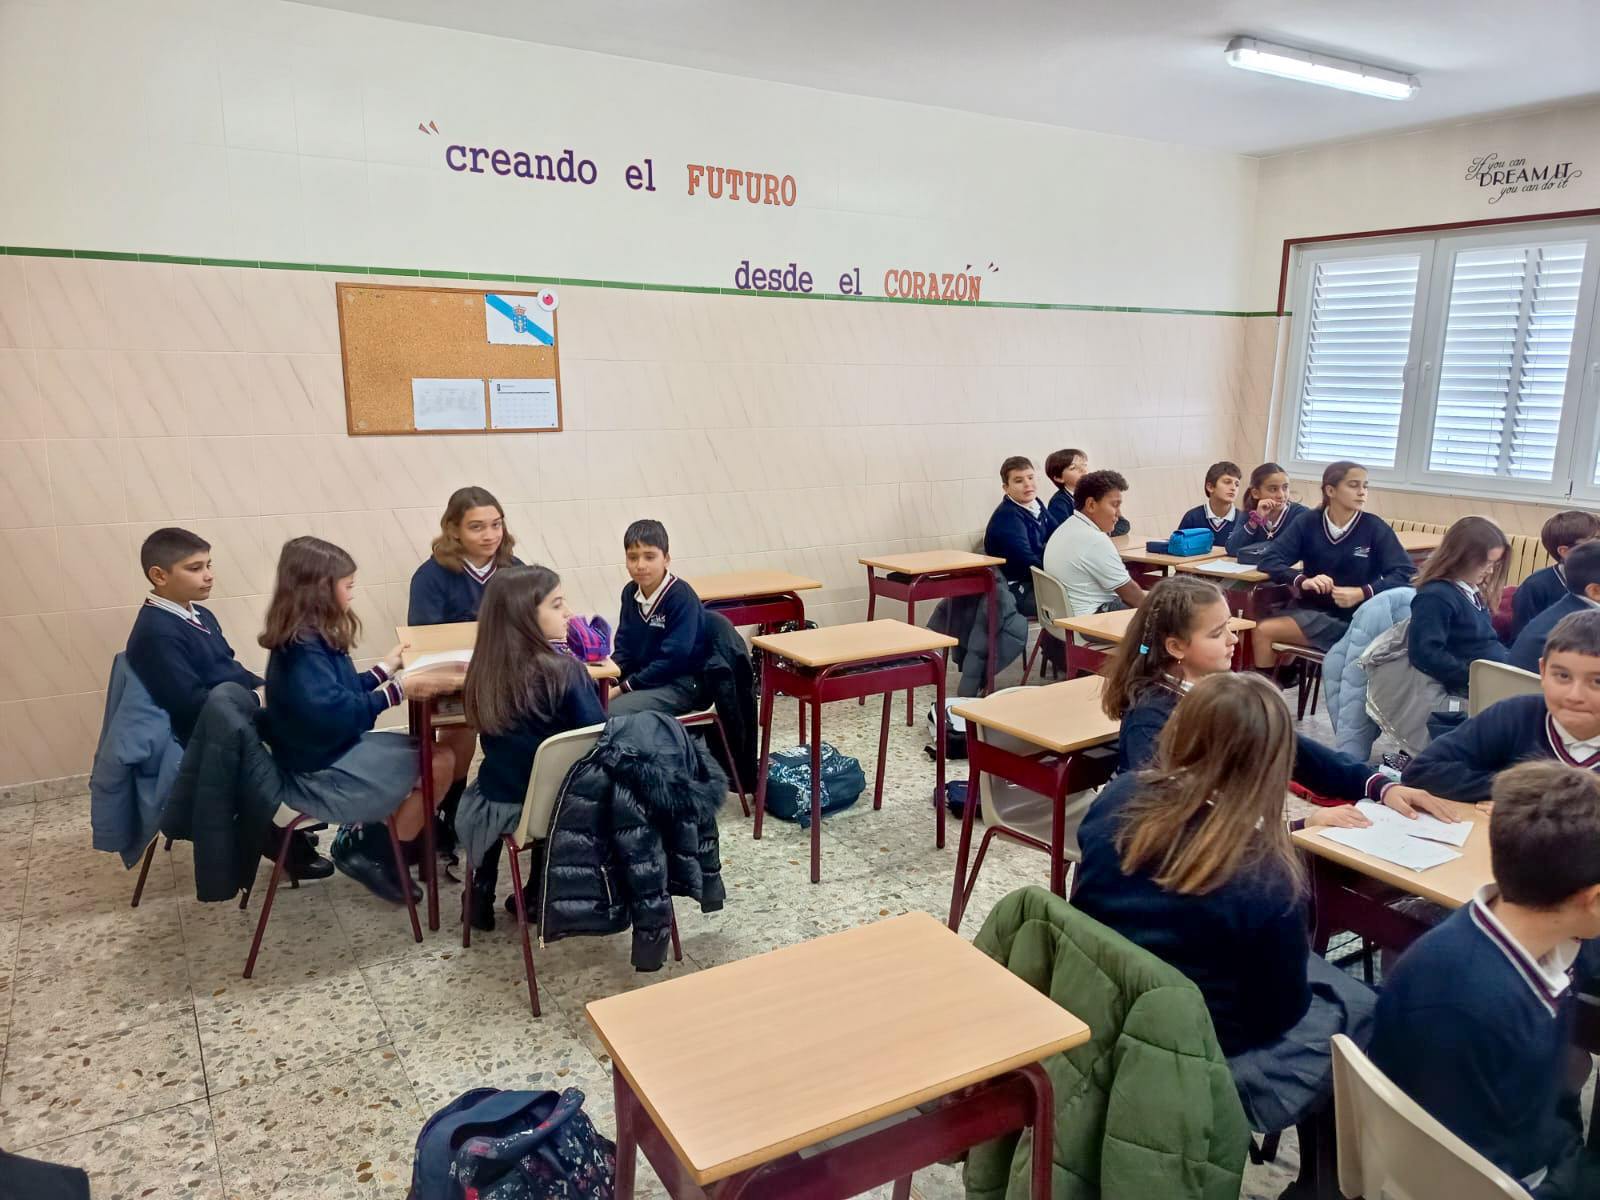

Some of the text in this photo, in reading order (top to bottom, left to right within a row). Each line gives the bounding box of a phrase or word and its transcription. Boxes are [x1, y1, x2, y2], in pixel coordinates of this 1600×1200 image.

[1480, 162, 1573, 187] DREAM IT
[1488, 161, 1506, 174] you
[1509, 158, 1526, 167] can
[625, 159, 656, 191] el
[687, 163, 797, 206] FUTURO
[1488, 186, 1518, 205] you
[1522, 183, 1538, 193] can
[1541, 174, 1555, 191] do
[734, 260, 813, 292] desde
[839, 267, 862, 296] el
